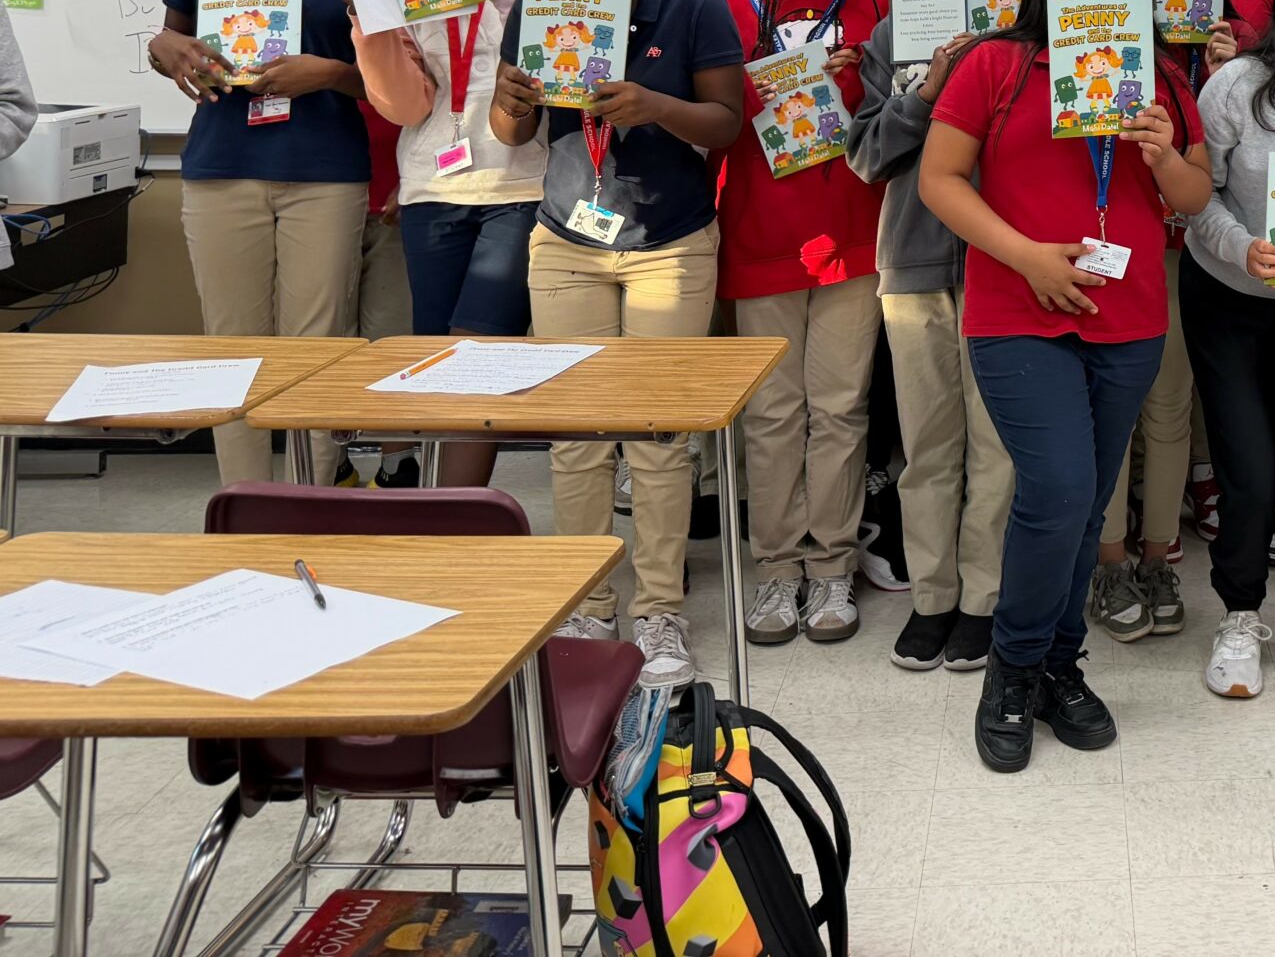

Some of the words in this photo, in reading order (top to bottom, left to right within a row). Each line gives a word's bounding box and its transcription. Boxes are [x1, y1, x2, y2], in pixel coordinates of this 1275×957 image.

[202, 1, 235, 11] CREDIT
[262, 0, 289, 7] CREW
[1076, 3, 1118, 13] Adventures
[526, 7, 559, 16] CREDIT
[561, 7, 587, 18] CARD
[587, 11, 616, 21] CREW
[1058, 10, 1131, 32] PENNY
[1053, 36, 1086, 48] CREDIT
[1087, 33, 1112, 44] CARD
[1113, 33, 1141, 42] CREW
[800, 74, 824, 87] CREW
[586, 125, 596, 152] SCHOOL
[1101, 150, 1111, 179] SCHOOL
[1086, 264, 1113, 276] STUDENT
